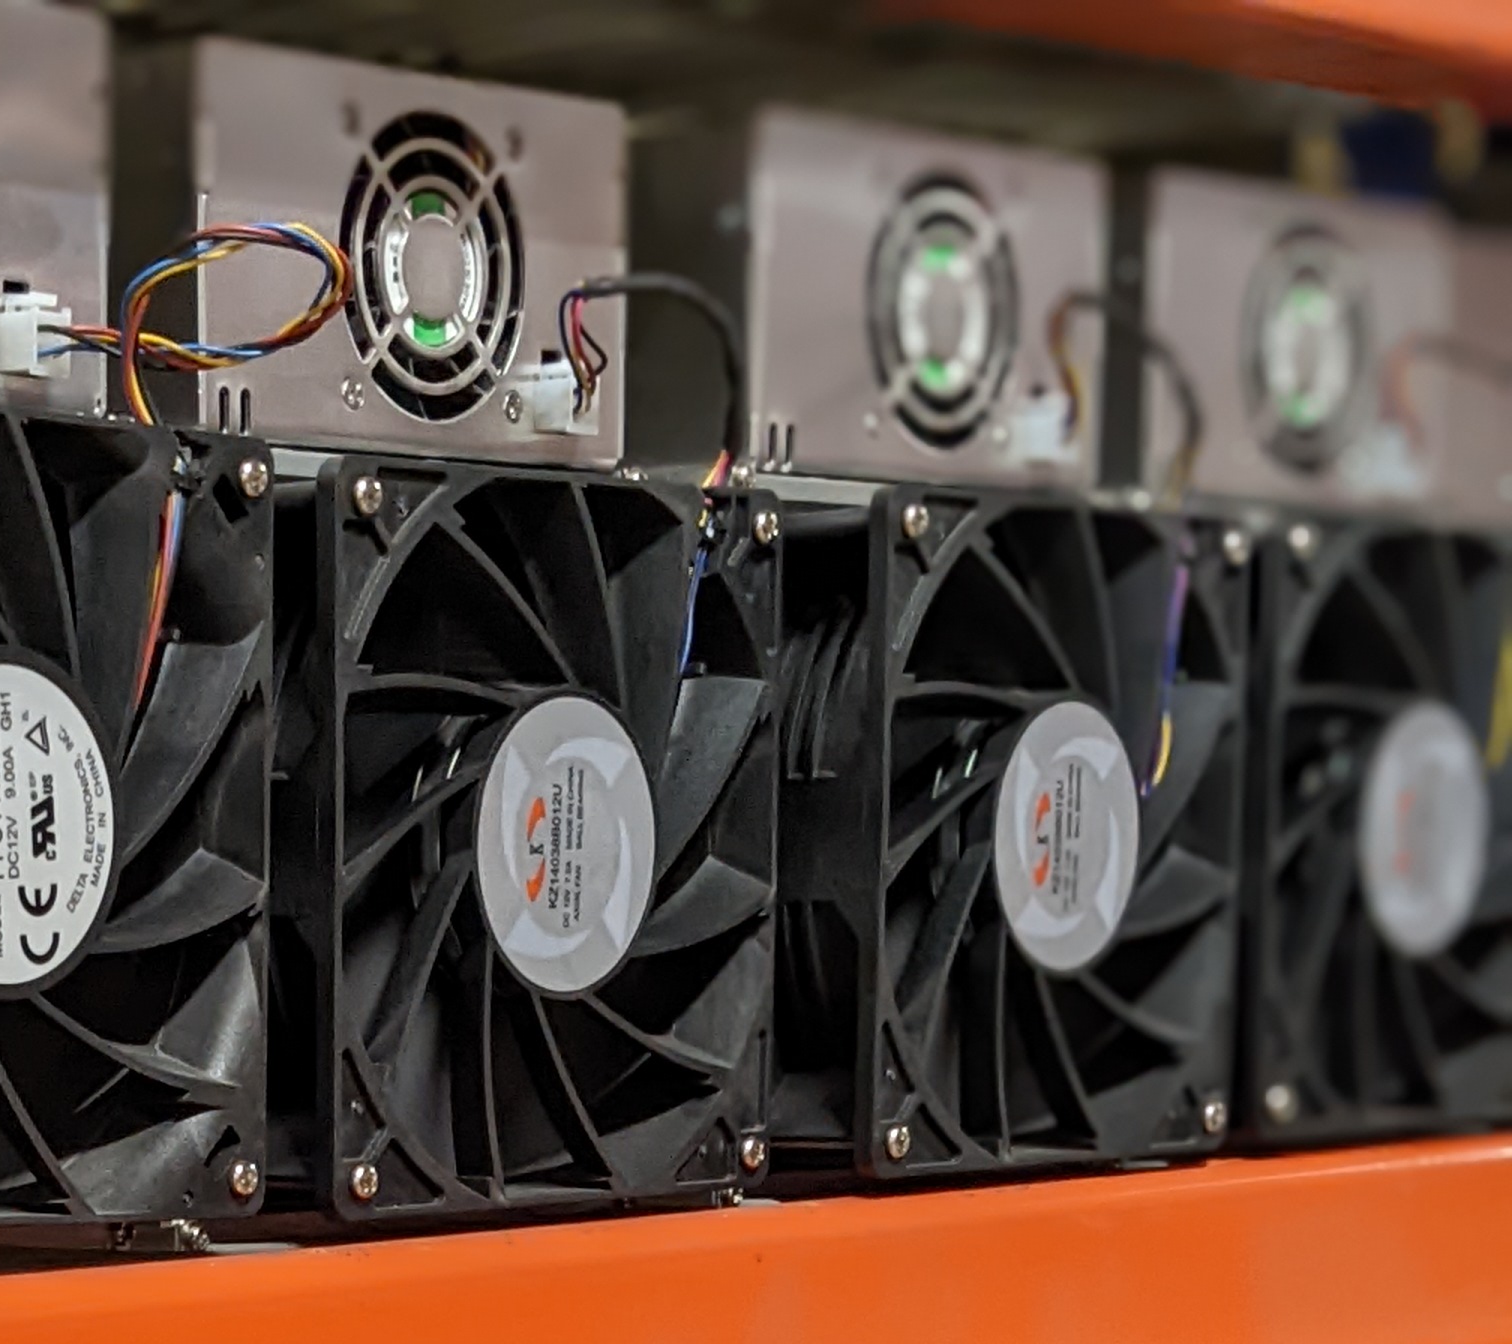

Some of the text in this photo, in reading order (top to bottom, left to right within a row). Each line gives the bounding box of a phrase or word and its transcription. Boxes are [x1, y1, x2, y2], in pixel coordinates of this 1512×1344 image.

[56, 724, 75, 753] INC.
[0, 690, 20, 880] DC12V 9.00A GH1
[84, 748, 107, 887] MADE IN CHINA
[529, 843, 544, 855] K
[66, 872, 89, 914] DELTA
